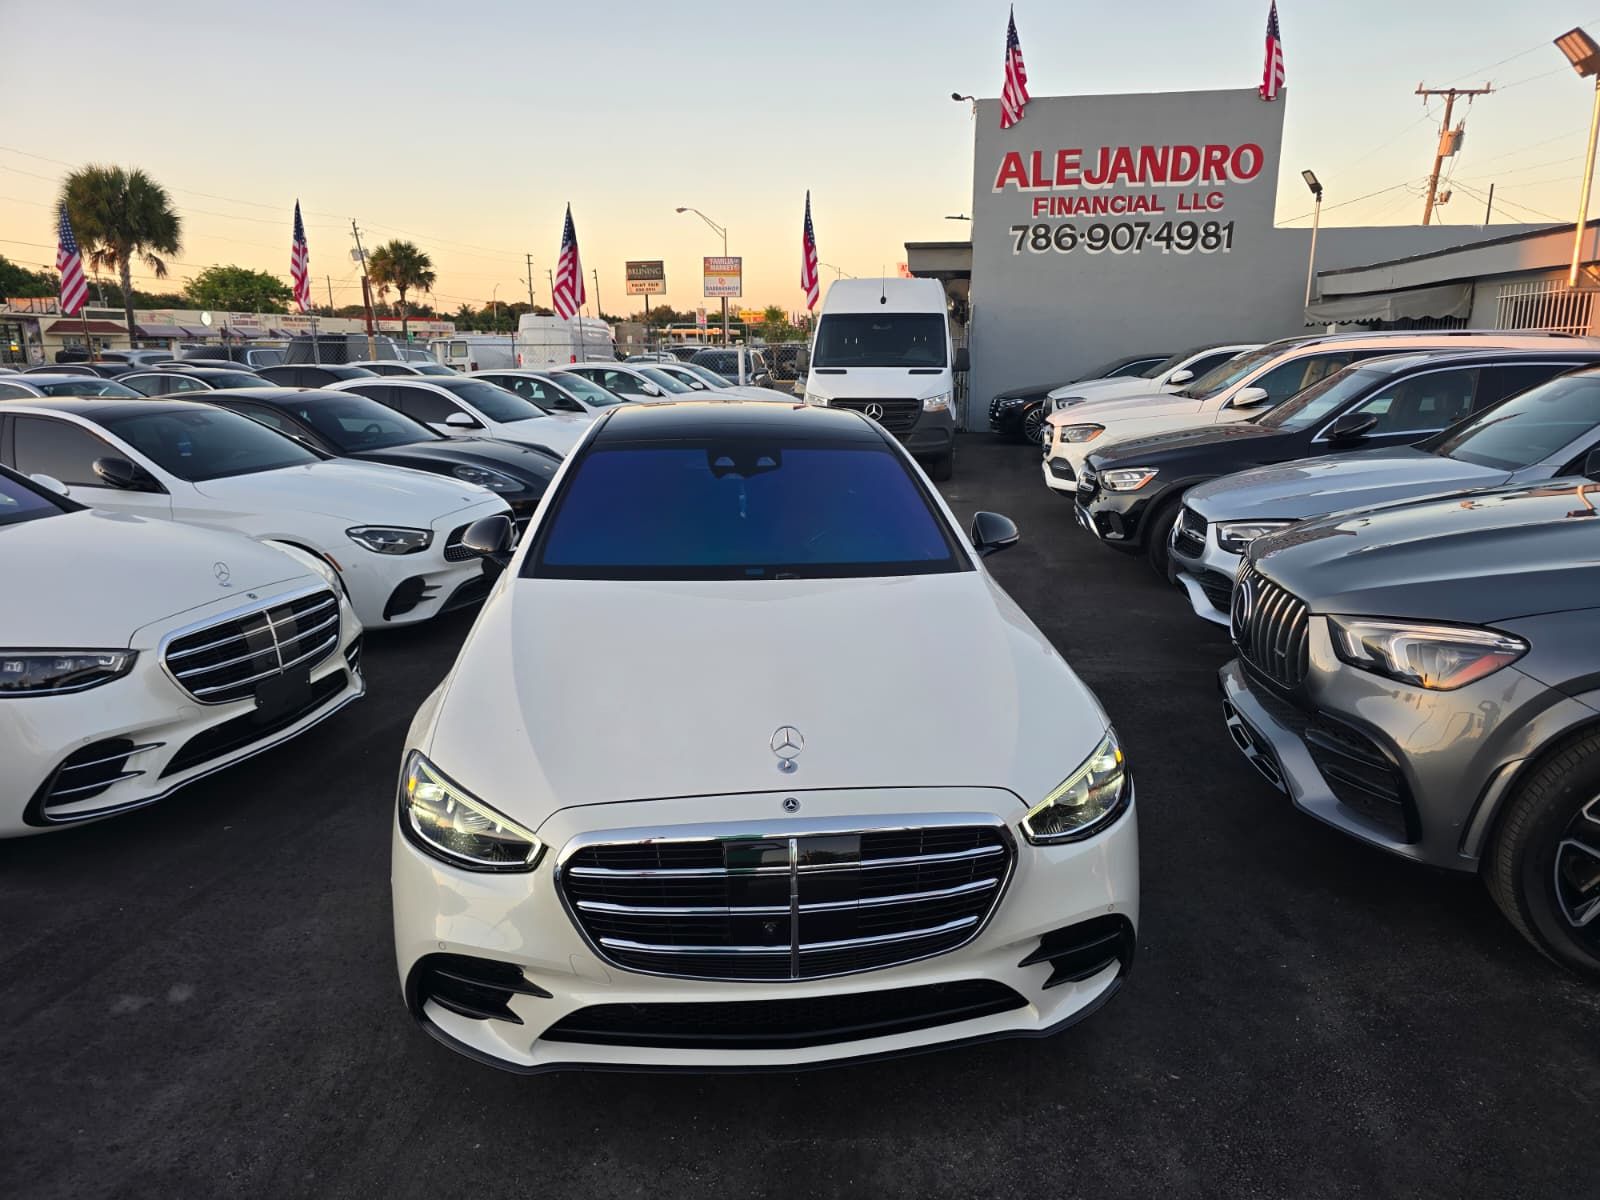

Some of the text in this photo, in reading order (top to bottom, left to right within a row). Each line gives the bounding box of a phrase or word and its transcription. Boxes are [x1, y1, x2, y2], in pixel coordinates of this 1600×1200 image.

[993, 144, 1264, 192] ALEJANDRO
[1032, 192, 1225, 218] FINANCIAL LLC
